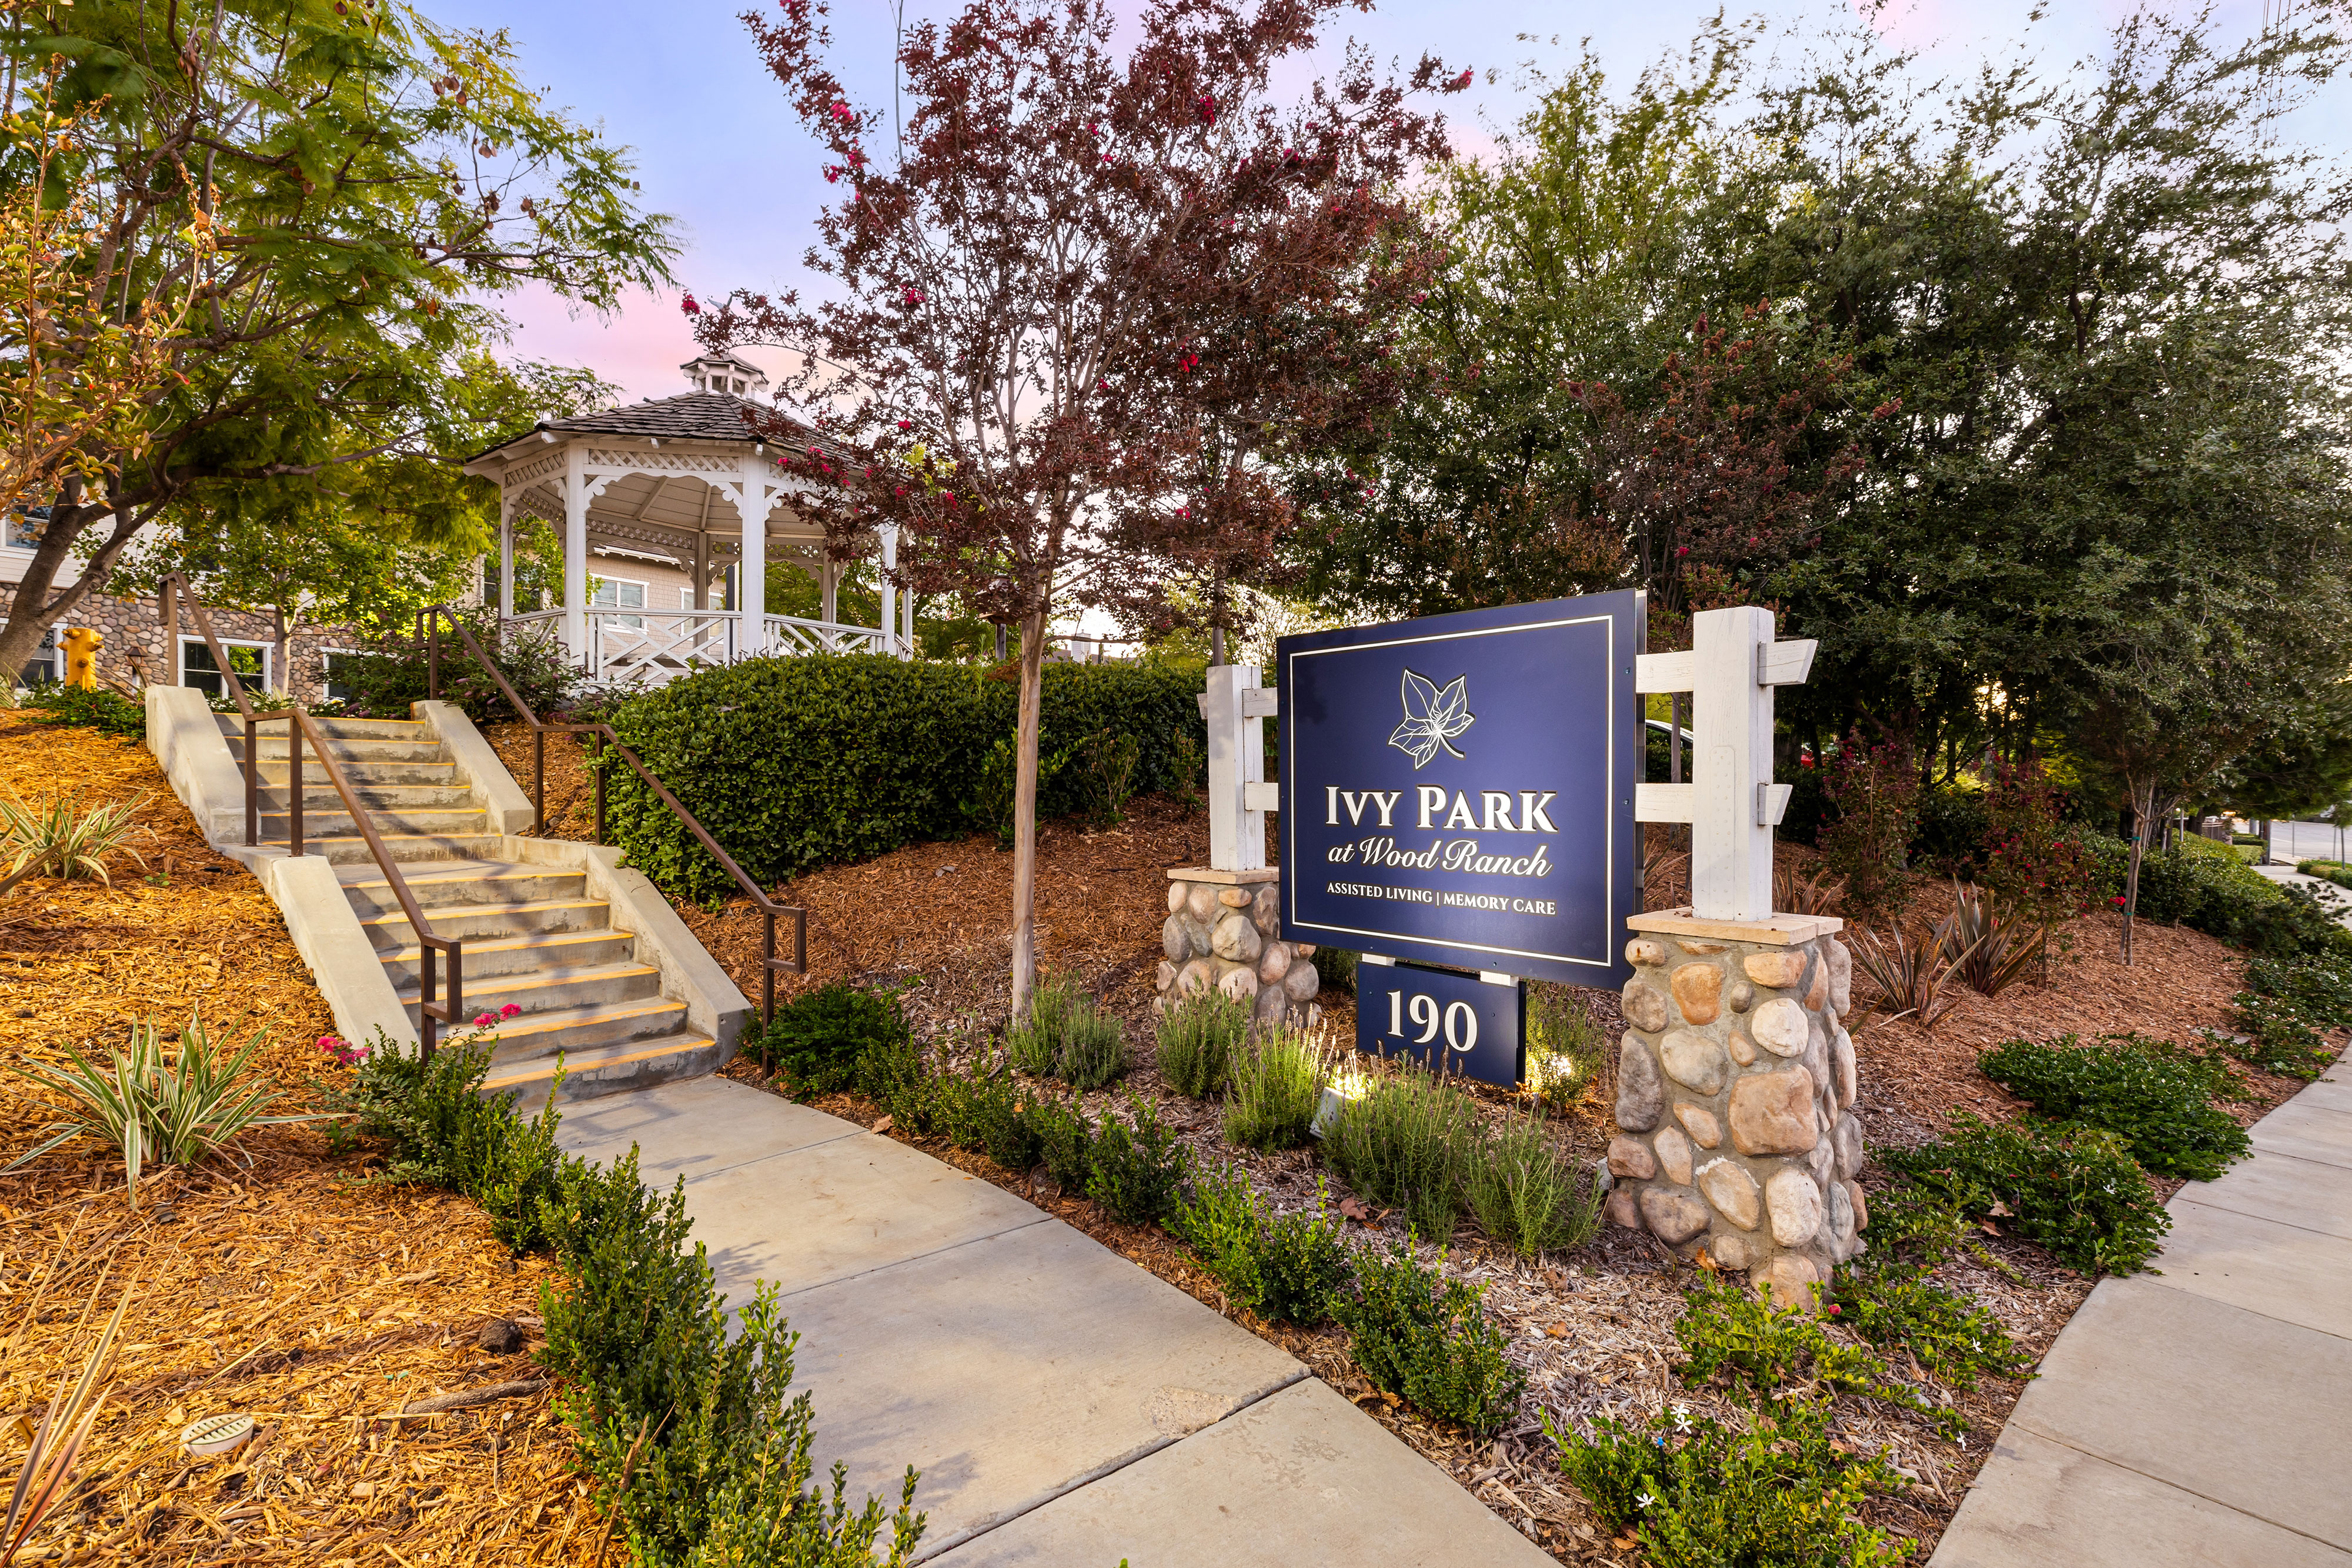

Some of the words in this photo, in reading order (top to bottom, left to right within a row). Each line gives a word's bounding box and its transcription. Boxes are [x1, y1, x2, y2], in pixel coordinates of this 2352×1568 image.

[1325, 786, 1402, 827] IVY
[1416, 784, 1559, 833] PARK
[1328, 844, 1356, 863] at
[1359, 837, 1442, 869] Wood
[1442, 840, 1553, 877] Ranch
[1327, 882, 1383, 898] ASSISTED
[1386, 887, 1433, 903] LIVING
[1443, 892, 1509, 911] MEMORY
[1513, 898, 1556, 915] CARE
[1387, 990, 1478, 1052] 190
